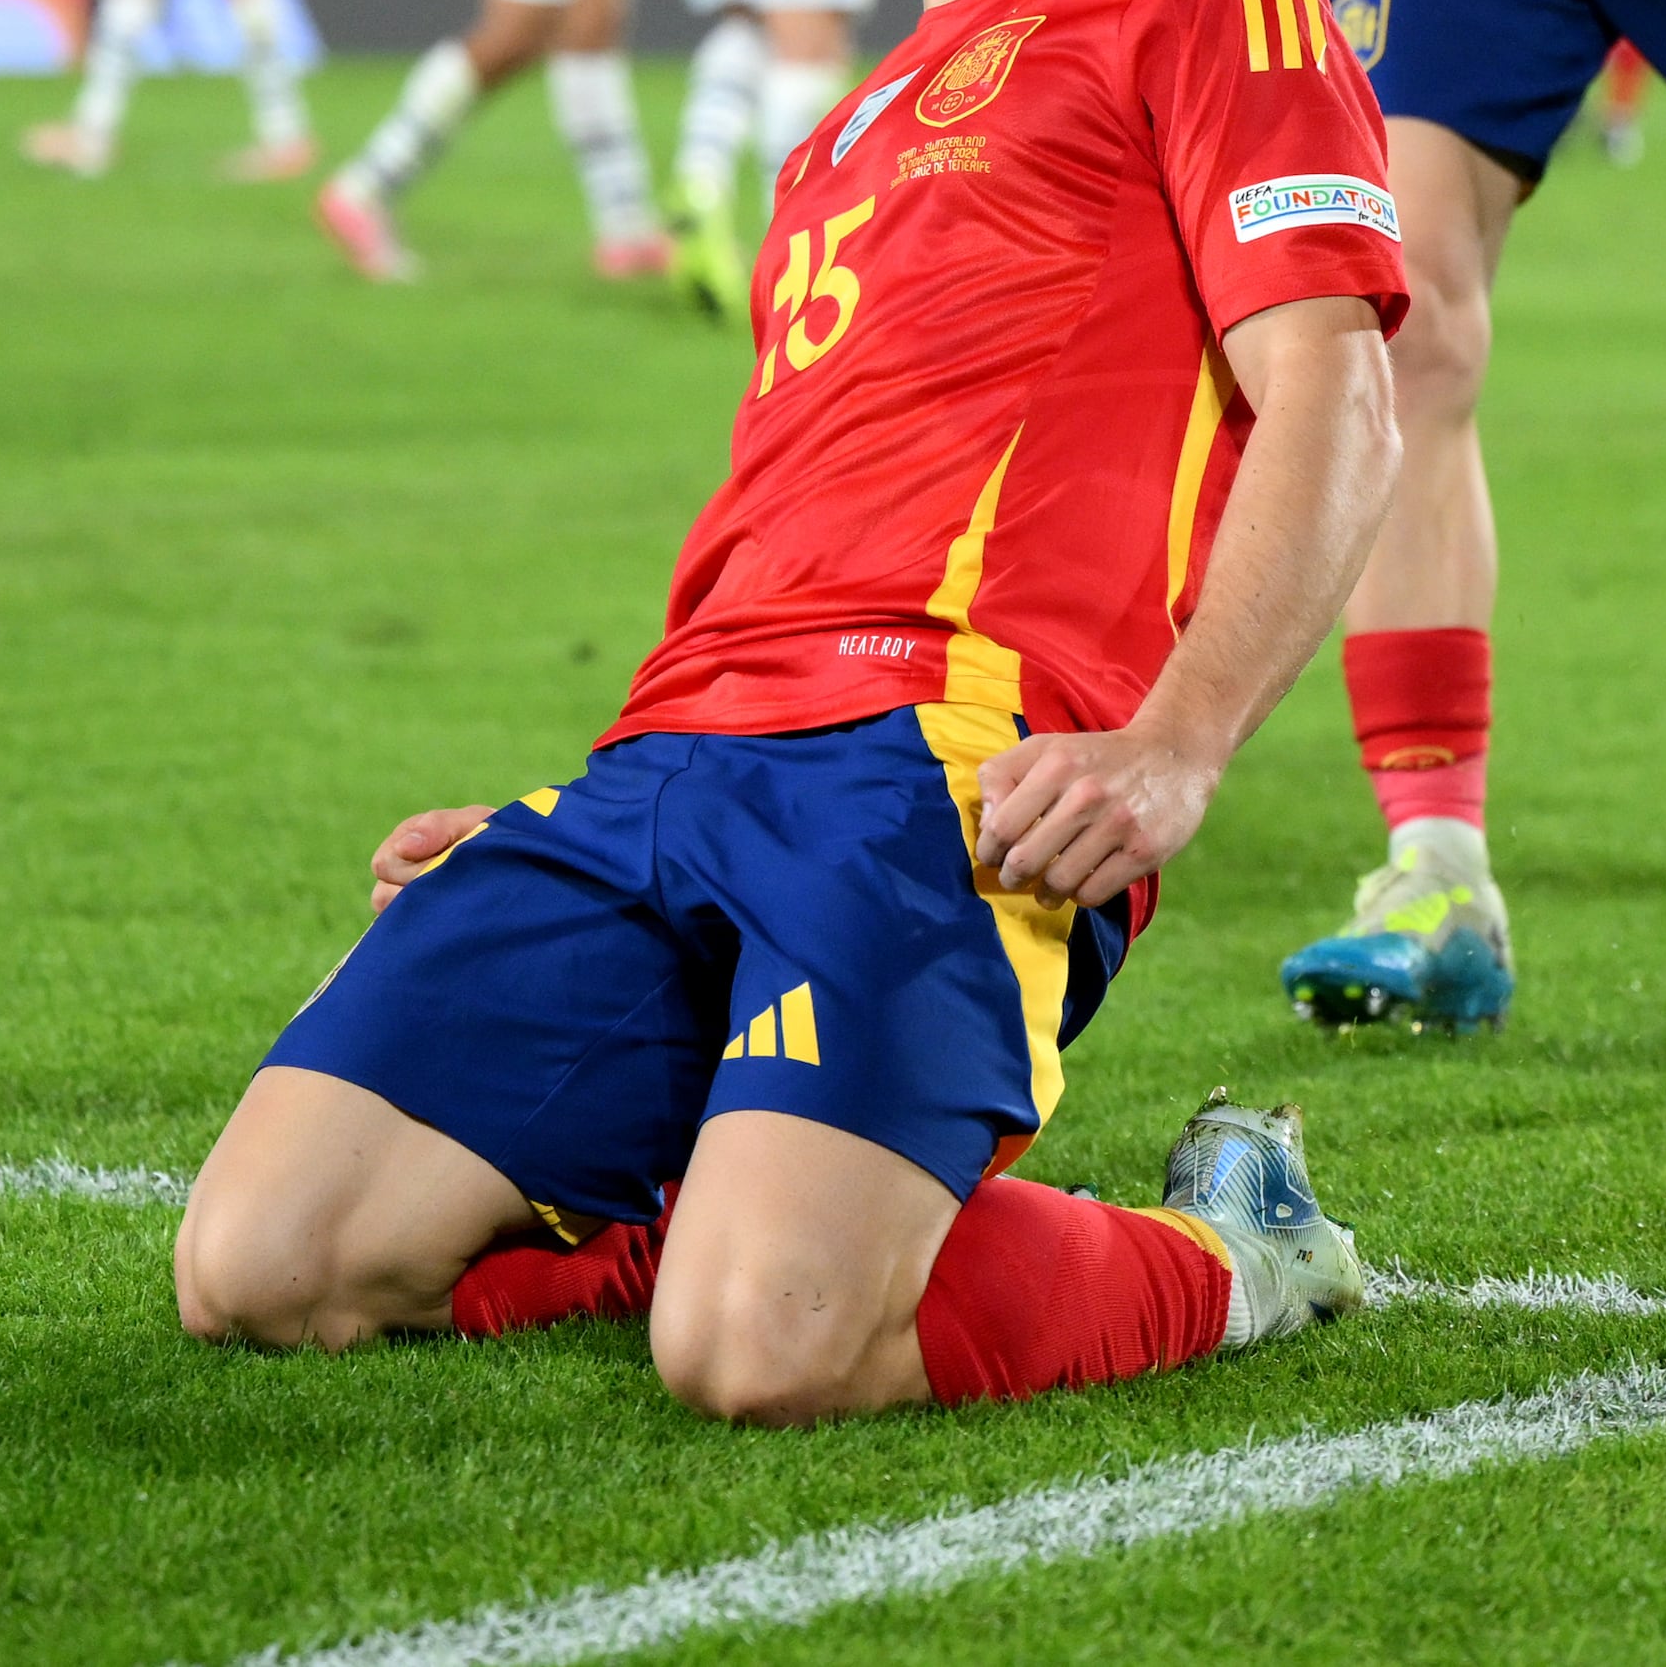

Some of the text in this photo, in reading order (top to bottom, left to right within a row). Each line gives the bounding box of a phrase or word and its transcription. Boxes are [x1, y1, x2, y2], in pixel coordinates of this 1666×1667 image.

[924, 136, 986, 153] SWITZERLAND
[907, 149, 950, 169] NOVEMBER
[952, 148, 978, 160] 2024
[910, 163, 932, 179] CRUZ
[933, 161, 945, 174] DE
[948, 159, 992, 174] TENERIFE
[1235, 184, 1273, 205] UEFA
[1237, 189, 1395, 224] FOUNDATION
[757, 195, 876, 400] 15
[838, 635, 916, 660] HEAT.RDY
